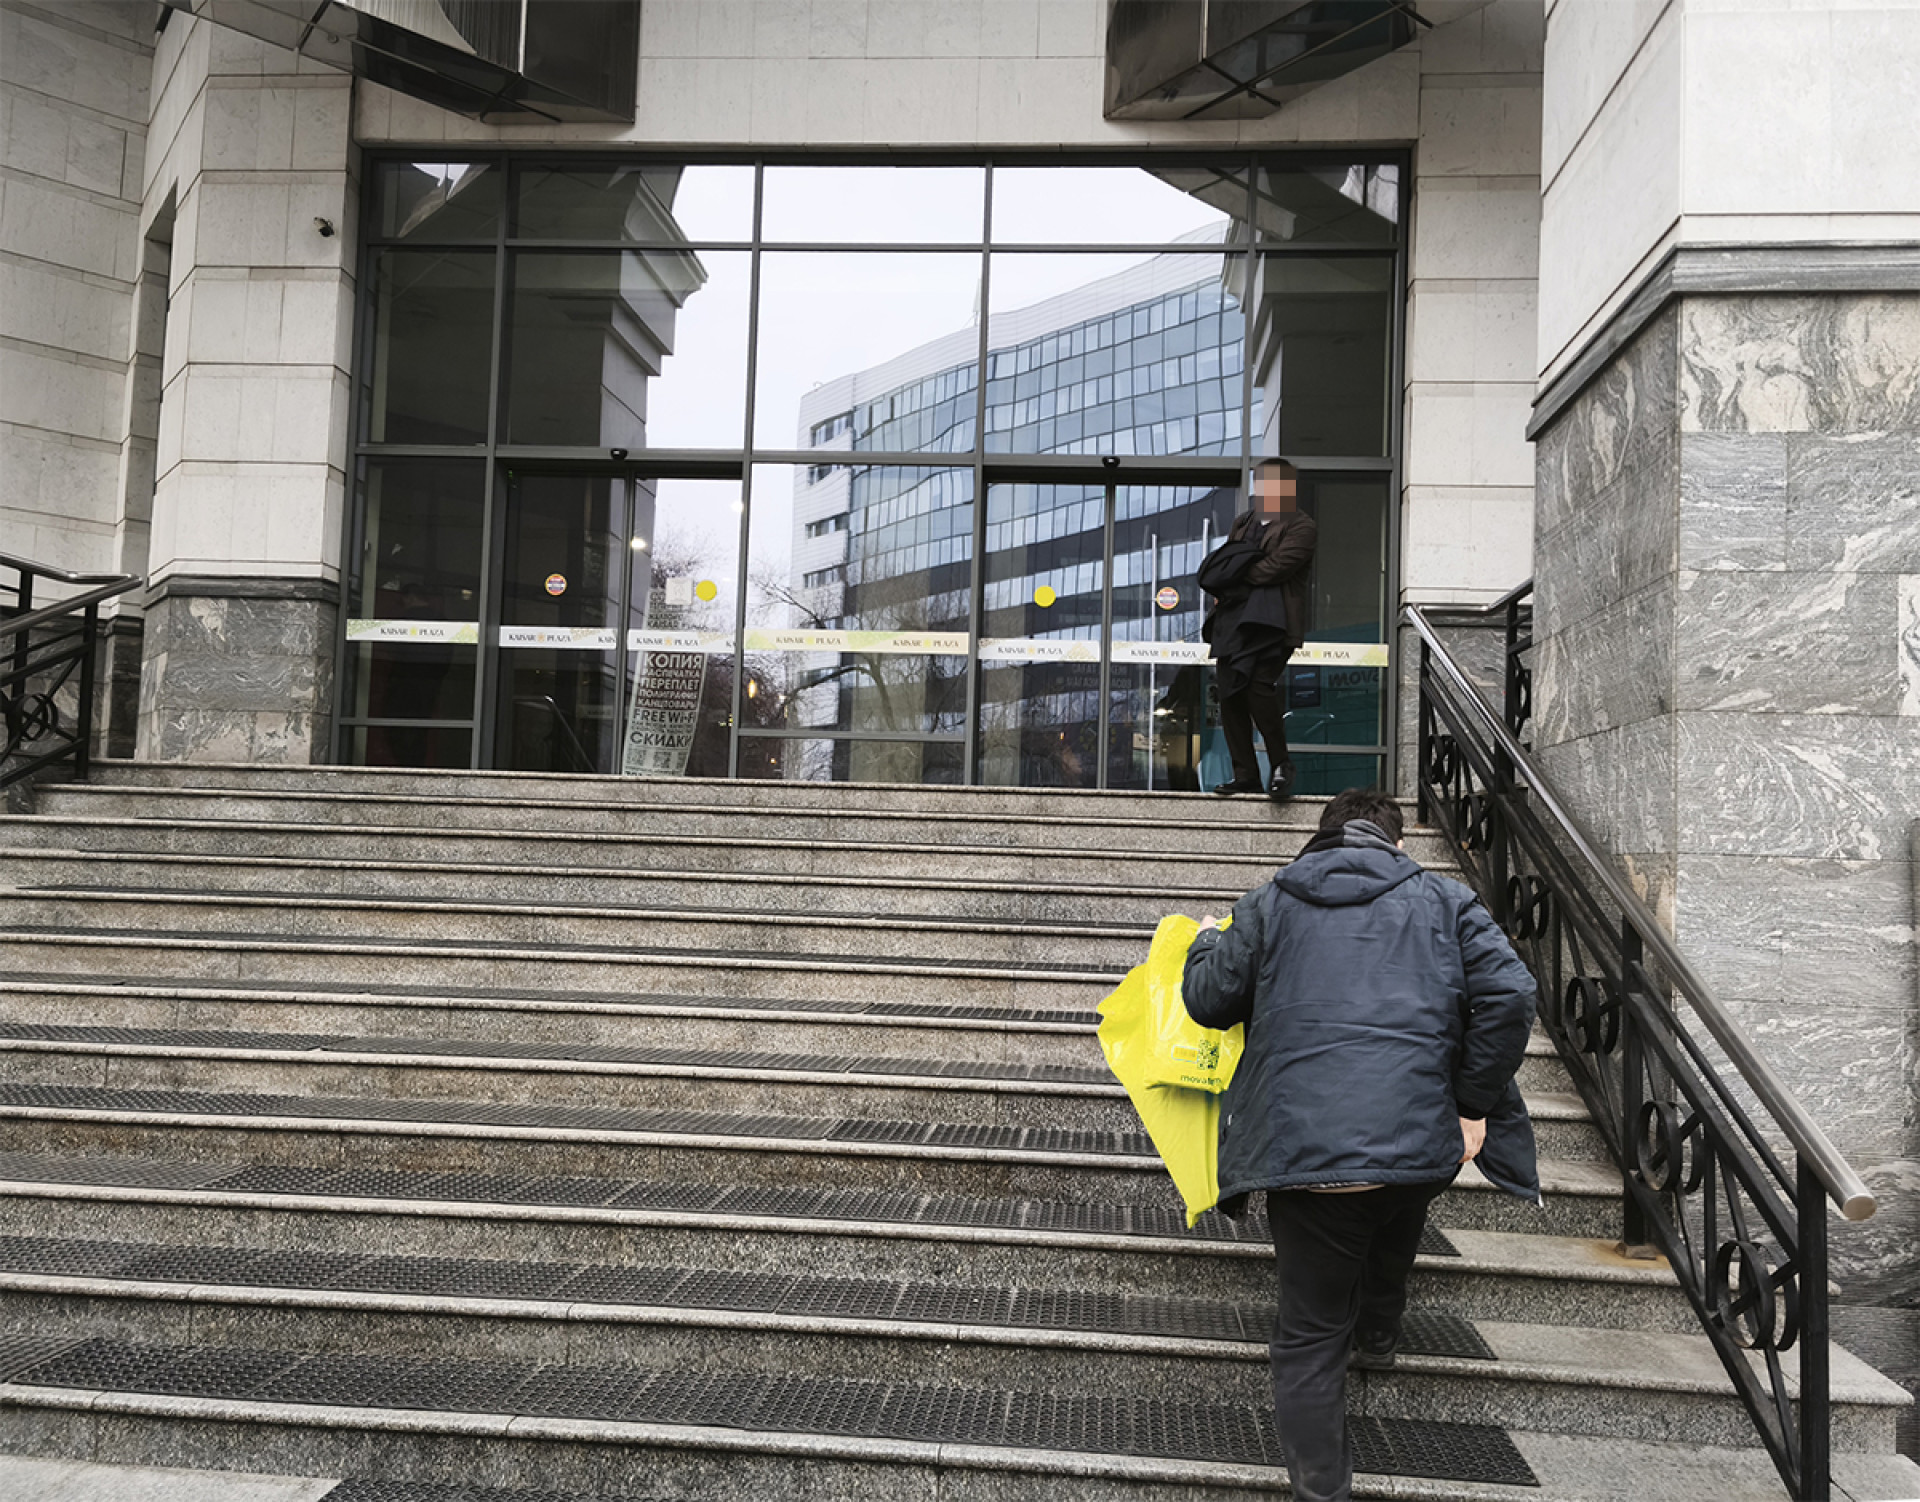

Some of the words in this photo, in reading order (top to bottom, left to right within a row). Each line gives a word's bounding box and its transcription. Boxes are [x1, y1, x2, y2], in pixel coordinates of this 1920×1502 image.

[419, 628, 444, 636] PLAZA
[674, 638, 699, 646] PLAZA
[815, 637, 841, 645] PLAZA
[1037, 647, 1063, 655] PLAZA
[1170, 650, 1197, 658] PLAZA
[1323, 650, 1350, 659] PLAZA
[644, 653, 703, 669] КОПИЯ
[641, 677, 700, 690] ПЕРЕПЛЕТ
[633, 709, 667, 722] FREE
